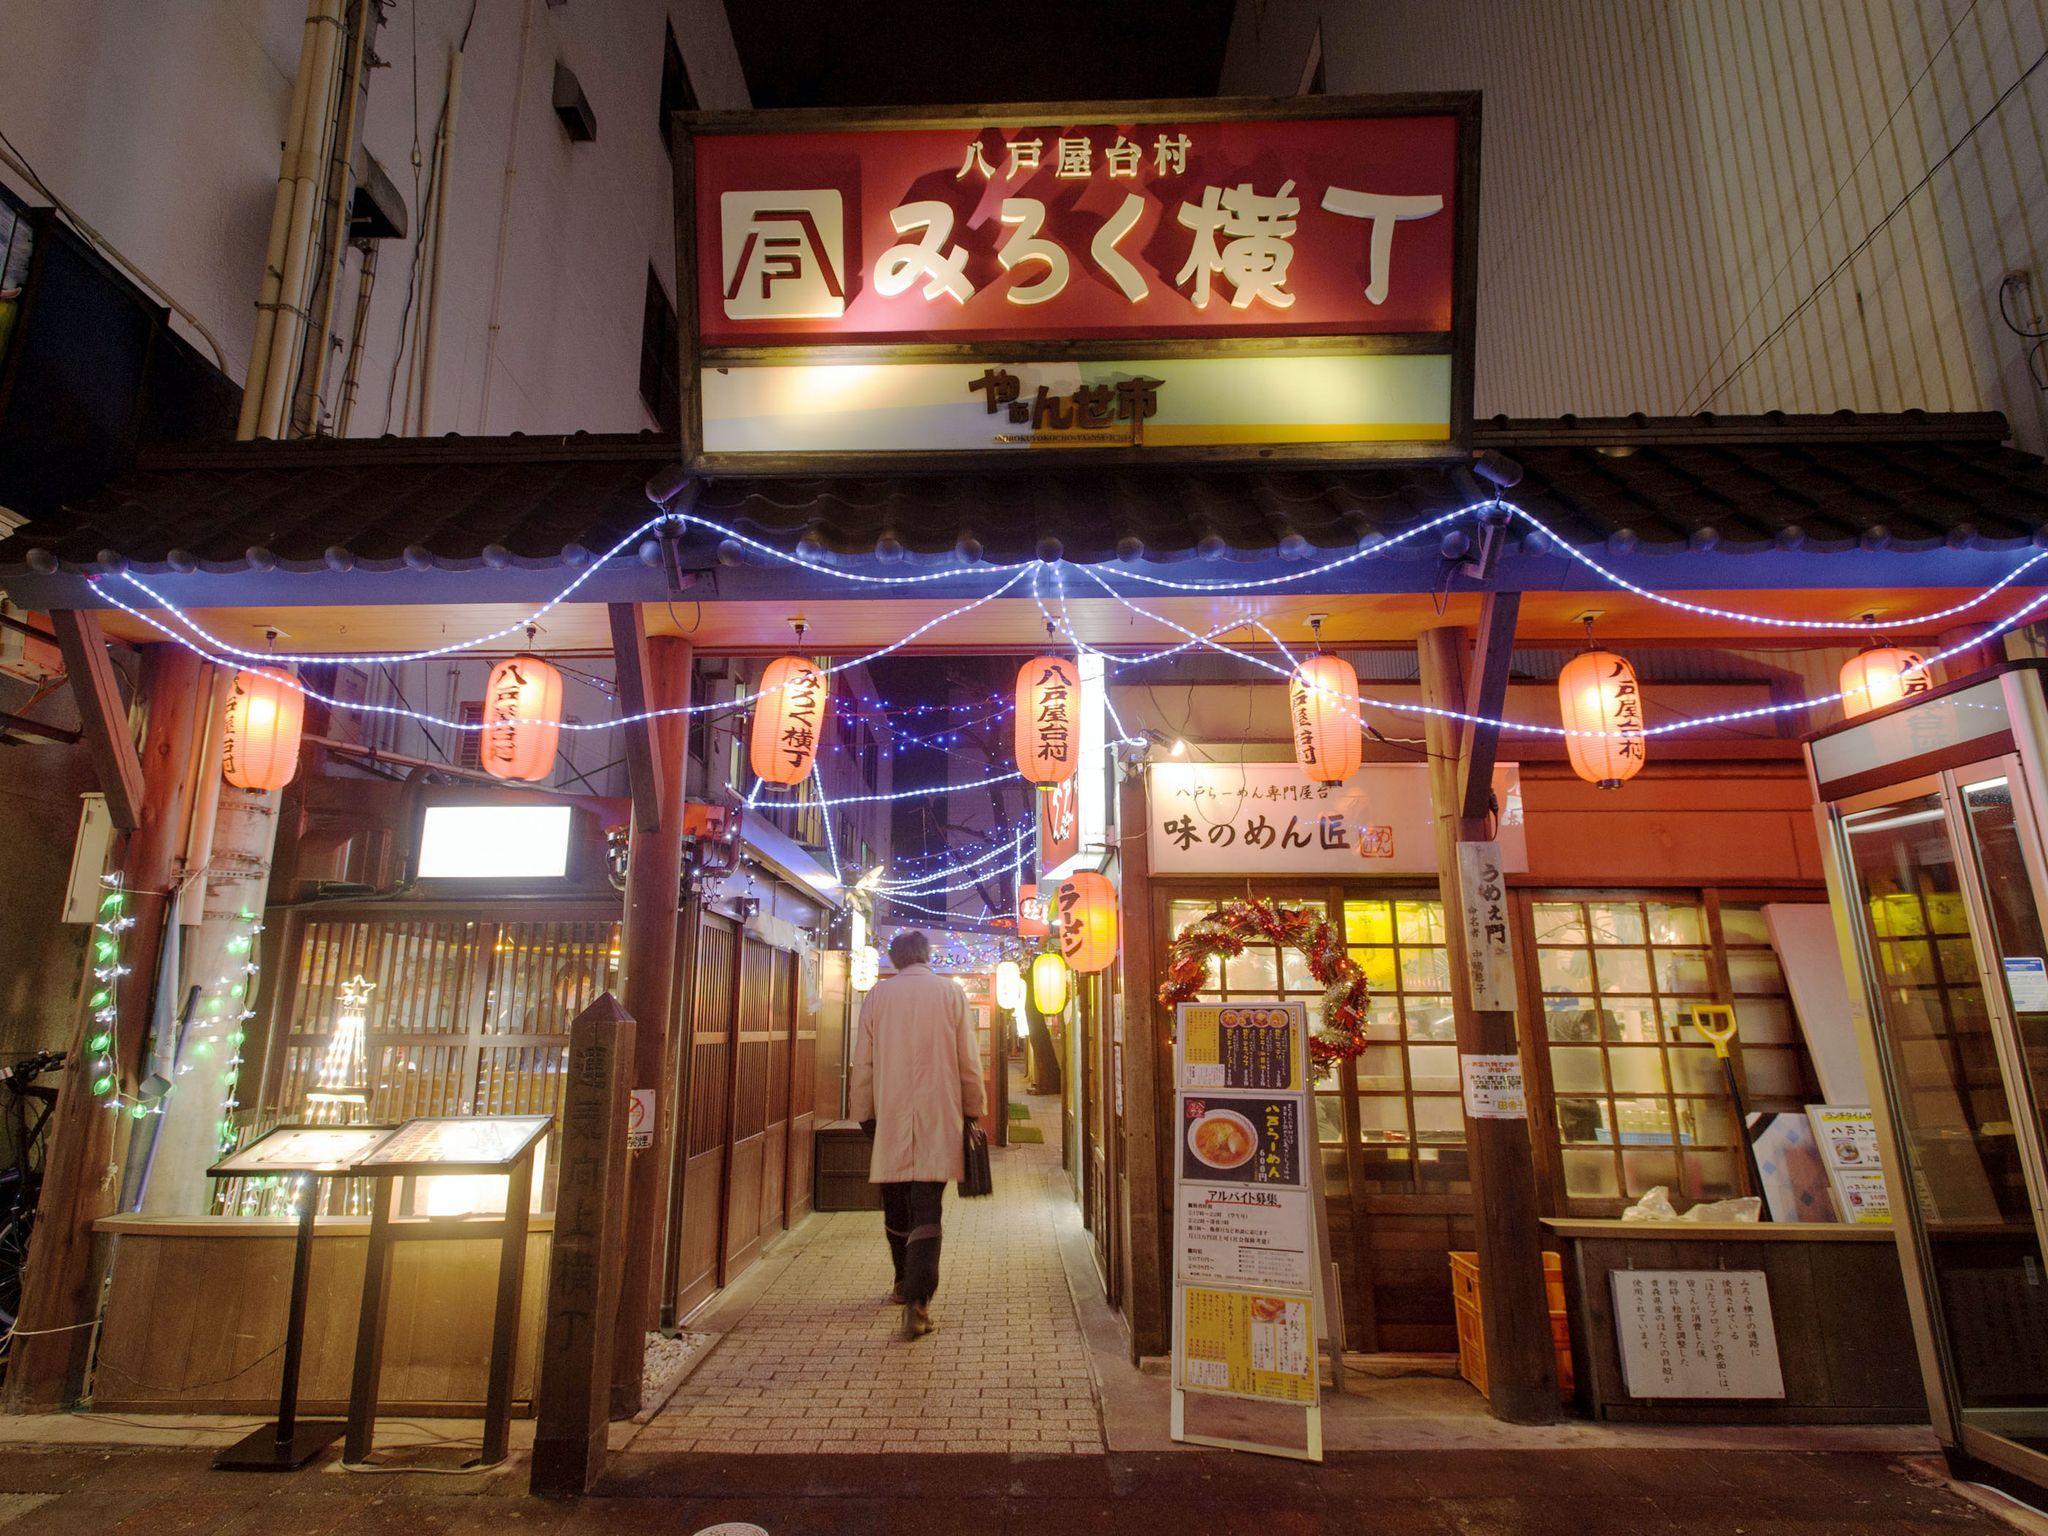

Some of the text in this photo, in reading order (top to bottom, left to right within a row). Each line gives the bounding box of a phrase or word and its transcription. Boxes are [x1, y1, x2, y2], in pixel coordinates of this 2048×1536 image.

[957, 134, 1192, 181] 八戸屋台村
[872, 178, 1444, 309] みろく横丁
[781, 669, 821, 768] みろく横丁
[1036, 665, 1073, 762] 八戸屋台村
[1176, 785, 1329, 802] 八戸らーめん専門屋台
[1163, 814, 1351, 851] 味のめん匠
[1059, 883, 1085, 957] ラーメン
[1258, 1149, 1268, 1182] 600円
[1265, 1105, 1281, 1178] 八戸らーめん
[1207, 1190, 1278, 1206] アルバイト募集
